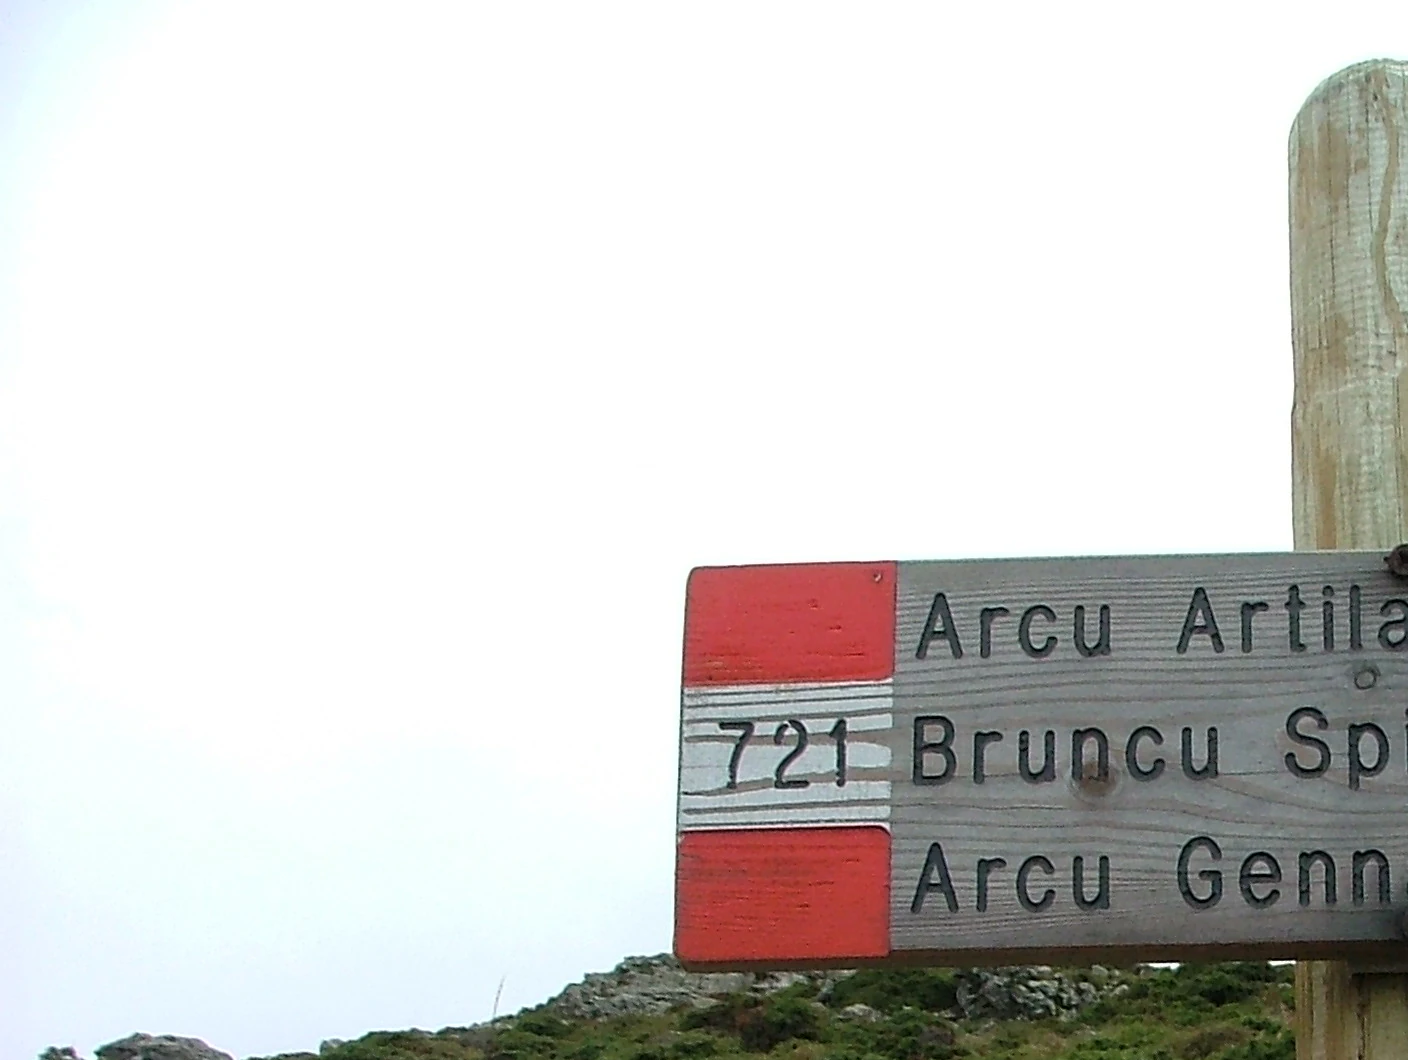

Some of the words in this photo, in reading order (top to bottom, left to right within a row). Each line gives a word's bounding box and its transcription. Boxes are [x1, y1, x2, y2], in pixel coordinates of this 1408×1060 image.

[915, 592, 1111, 659] Arcu
[719, 718, 847, 789] 721
[912, 715, 1219, 785] Bruncu
[910, 842, 1111, 914] Arcu
